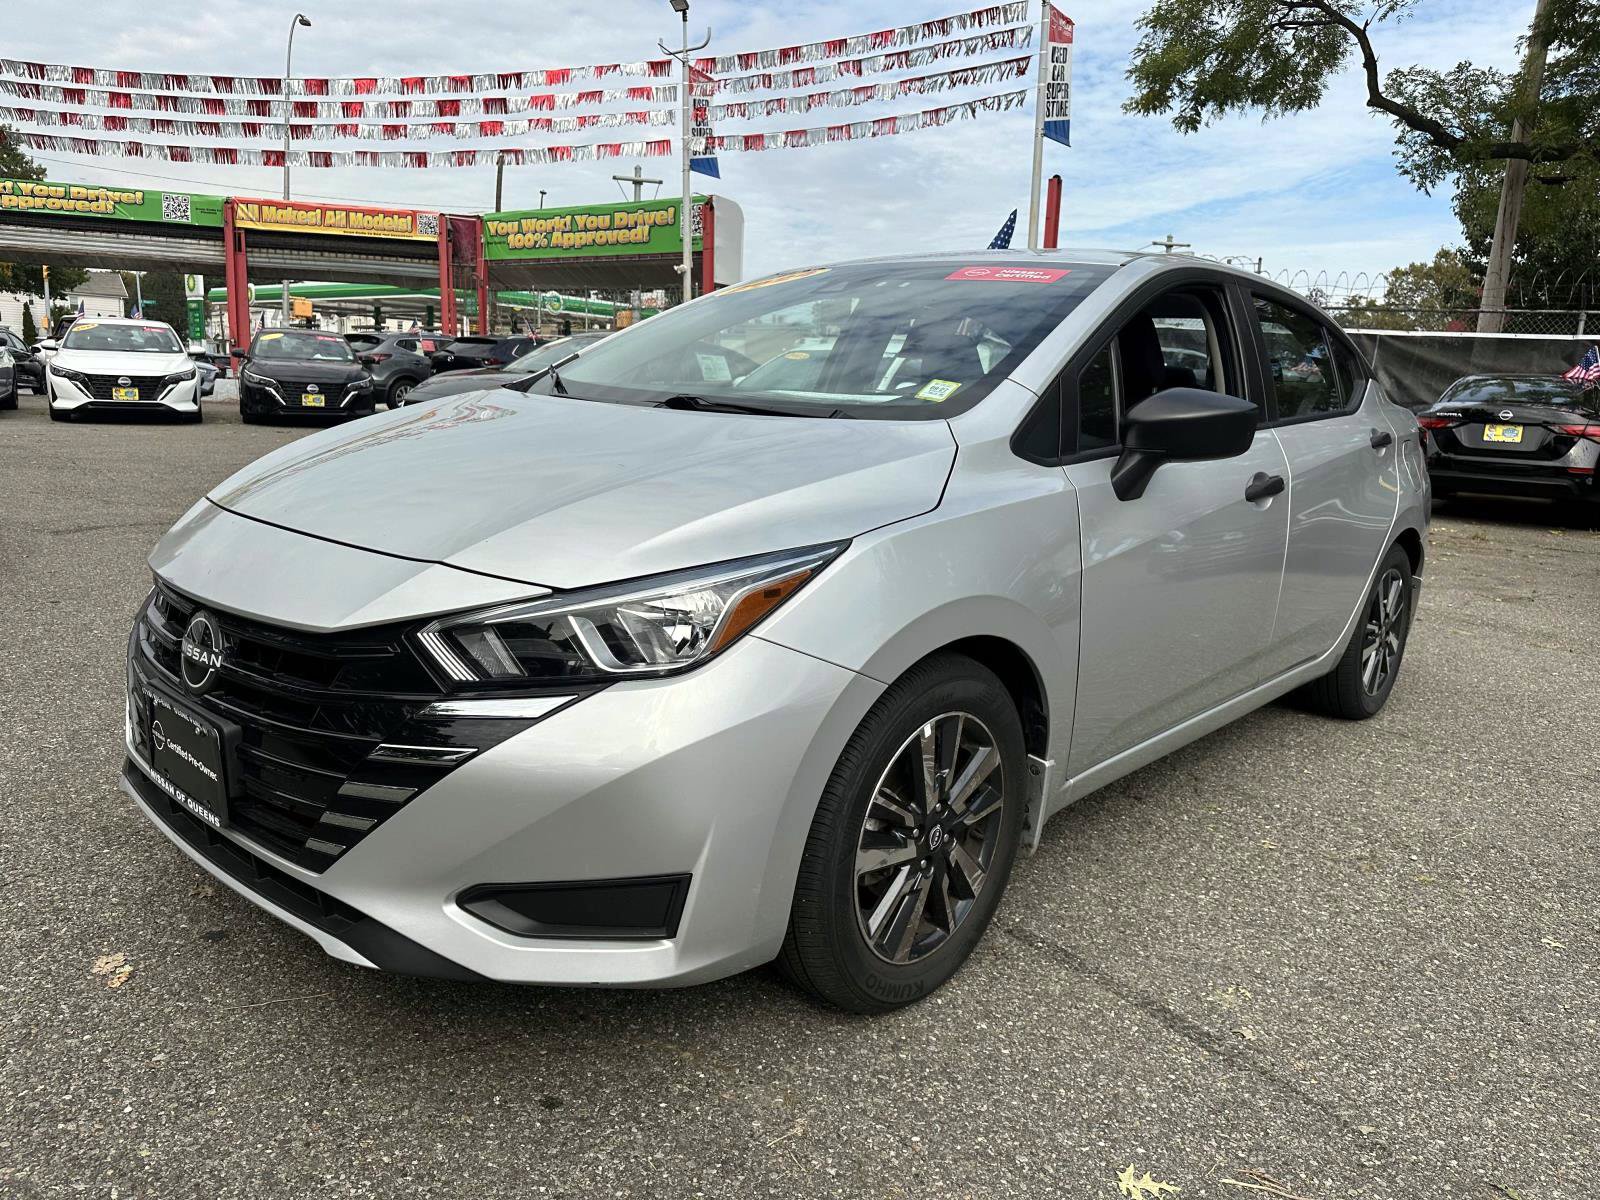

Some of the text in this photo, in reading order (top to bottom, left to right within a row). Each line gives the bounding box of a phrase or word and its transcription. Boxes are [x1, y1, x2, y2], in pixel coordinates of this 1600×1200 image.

[1051, 46, 1068, 64] USED
[1052, 65, 1065, 81] CAR
[1046, 82, 1069, 99] SUPER
[1045, 100, 1069, 118] STORE
[0, 194, 114, 213] pproved!
[16, 181, 66, 198] You
[70, 186, 144, 204] Drive!
[236, 203, 413, 233] All Makes! All Models!
[487, 206, 675, 236] You Work! You Drive!
[507, 225, 648, 249] 100% Approved!
[166, 738, 188, 760] Certified
[150, 768, 220, 828] NISSAN OF QUEENS
